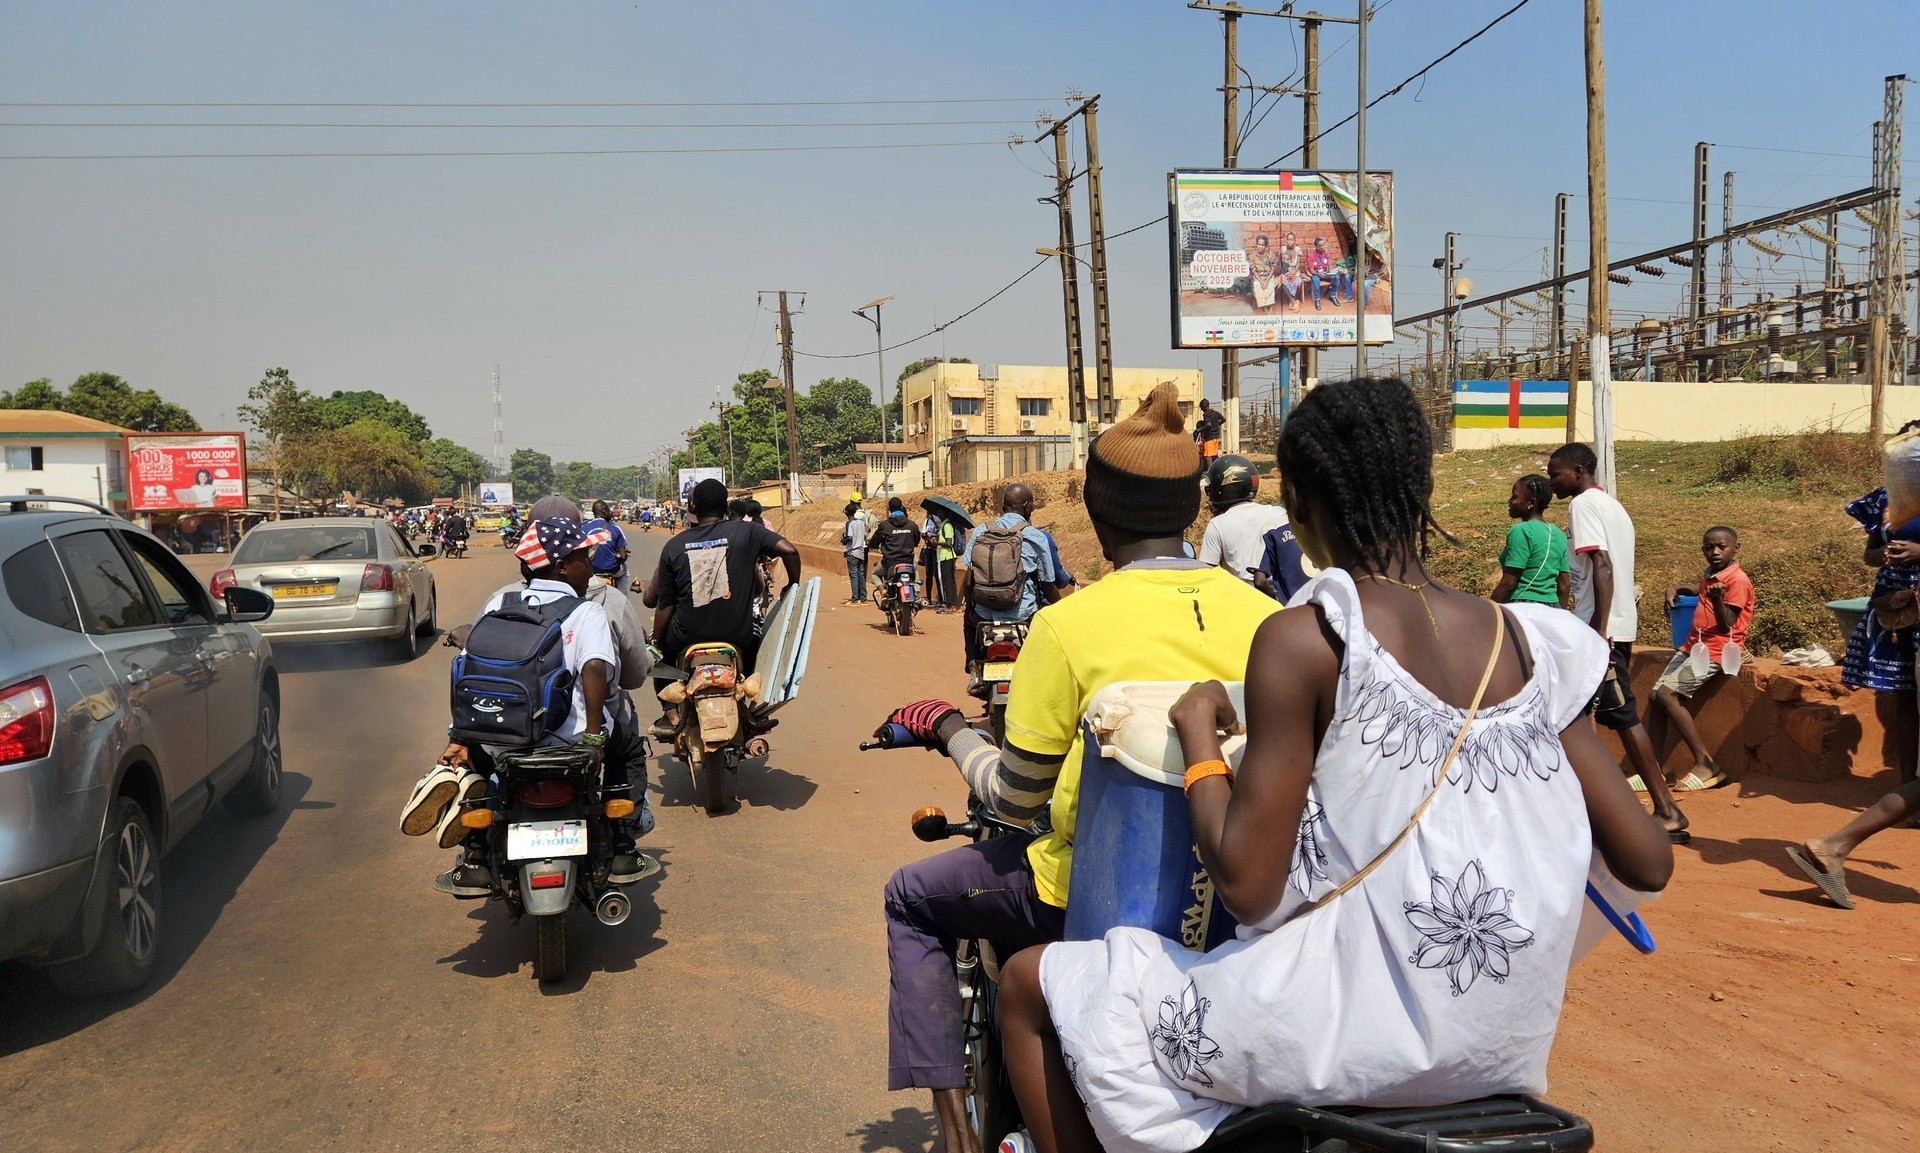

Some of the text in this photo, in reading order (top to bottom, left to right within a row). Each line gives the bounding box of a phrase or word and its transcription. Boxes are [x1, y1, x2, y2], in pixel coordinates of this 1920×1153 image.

[1196, 254, 1242, 263] OCTOBRE
[1193, 264, 1246, 273] NOVEMBRE
[1210, 276, 1231, 284] 2025
[137, 450, 172, 464] 100%
[186, 450, 236, 460] 1000 000F
